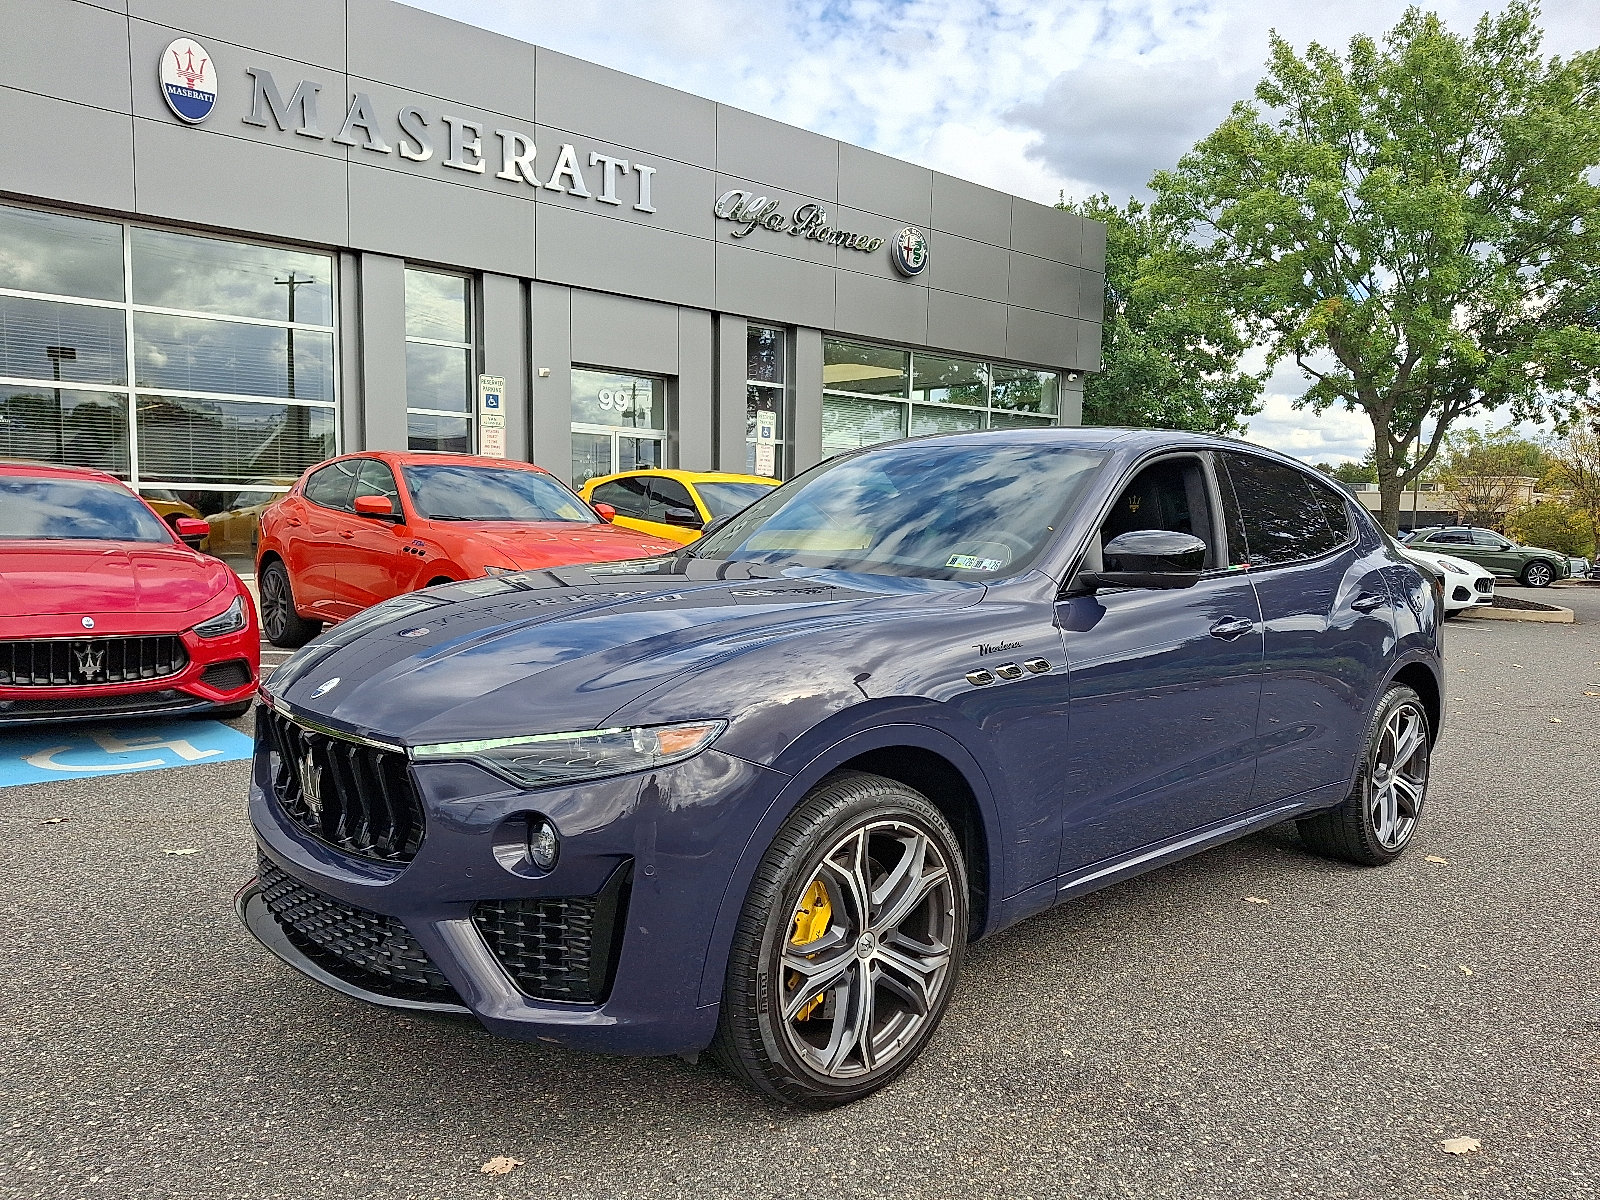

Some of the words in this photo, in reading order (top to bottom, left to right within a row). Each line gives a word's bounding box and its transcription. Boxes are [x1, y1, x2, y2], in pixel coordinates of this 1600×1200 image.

[167, 85, 213, 102] MASERATI
[242, 66, 657, 213] MASERATI
[714, 189, 789, 238] Alfa
[788, 203, 886, 253] Romeo
[598, 388, 629, 412] 99
[972, 640, 1023, 656] Modena
